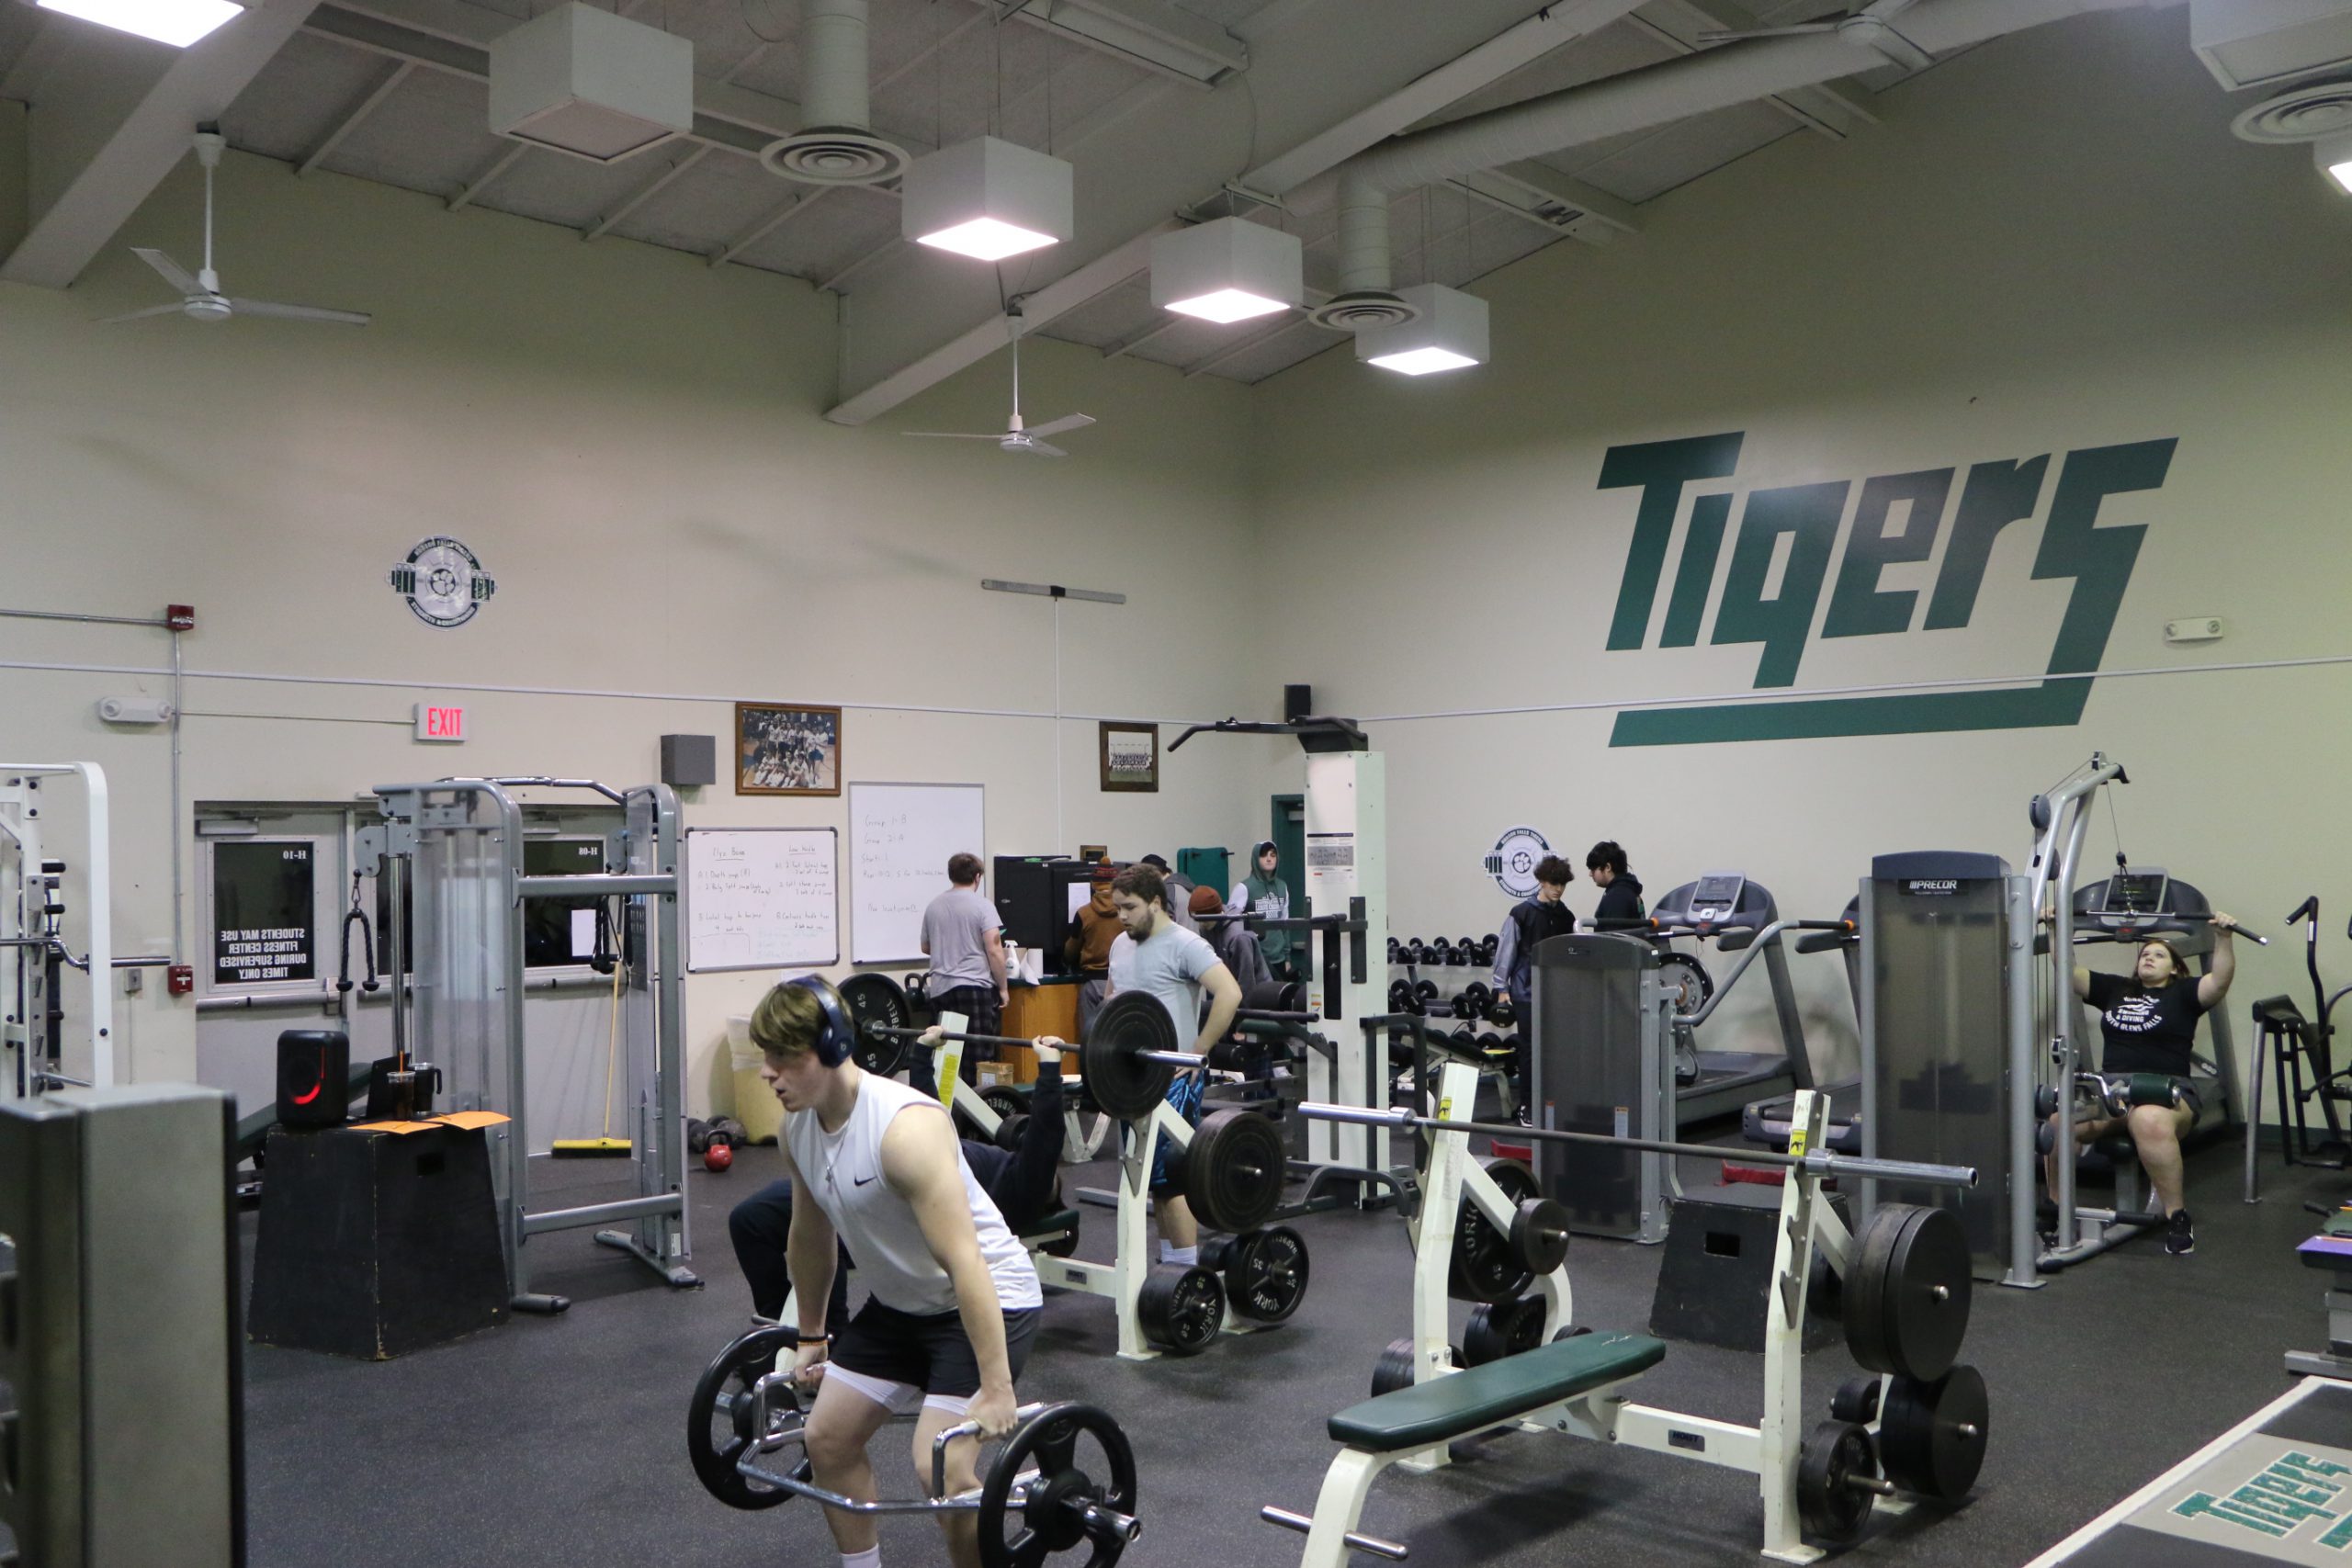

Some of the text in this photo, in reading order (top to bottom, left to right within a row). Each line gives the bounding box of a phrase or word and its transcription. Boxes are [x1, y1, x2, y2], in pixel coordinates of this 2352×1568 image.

[1597, 431, 2179, 747] Tigers
[427, 707, 463, 737] EXIT
[1910, 880, 1958, 889] PRECOR
[857, 993, 867, 1009] 45
[886, 998, 899, 1044] BRBELL
[2120, 1023, 2143, 1032] GLENS
[2143, 1014, 2163, 1031] FALLS
[2121, 1014, 2145, 1022] DIVING
[866, 1053, 876, 1068] 45
[1252, 1258, 1265, 1270] 35
